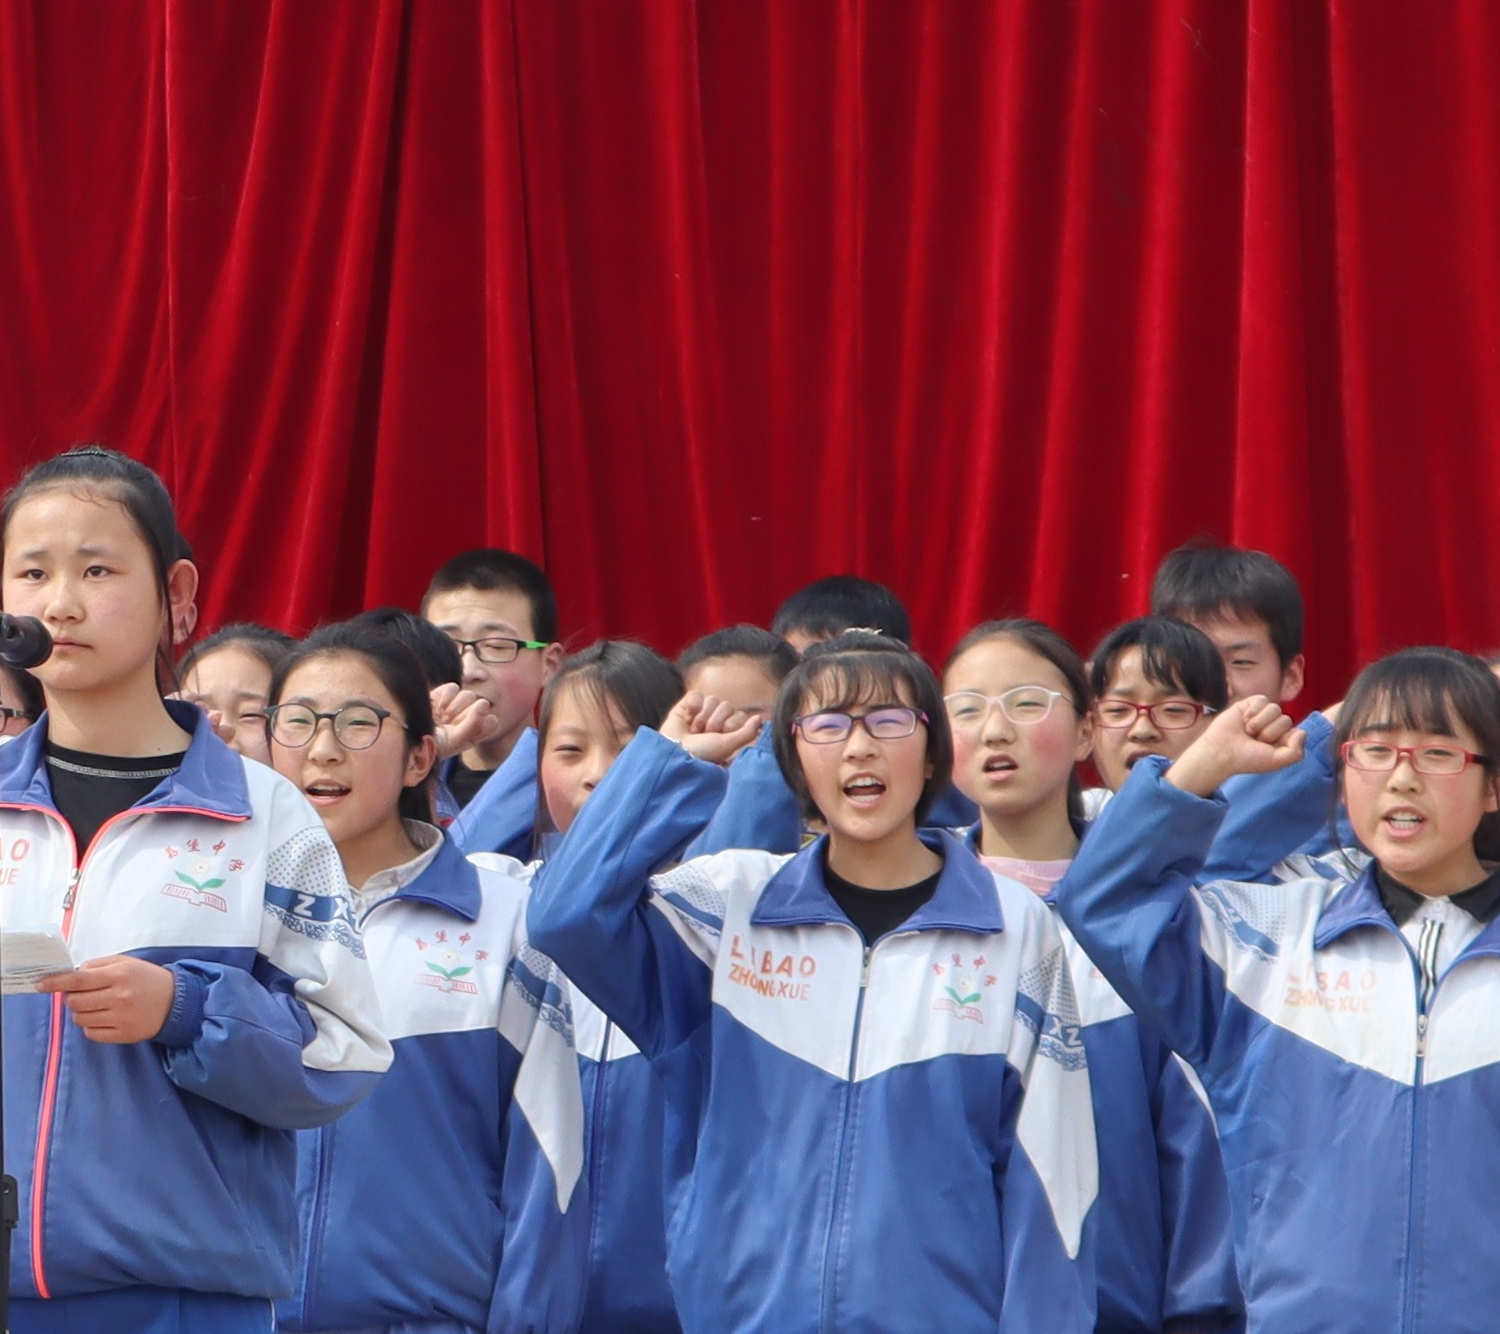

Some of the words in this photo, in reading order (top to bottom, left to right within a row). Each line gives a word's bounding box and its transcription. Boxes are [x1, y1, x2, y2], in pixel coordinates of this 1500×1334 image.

[729, 934, 818, 979] LIBAO
[727, 962, 776, 998] ZHONG
[777, 980, 812, 1002] XUE
